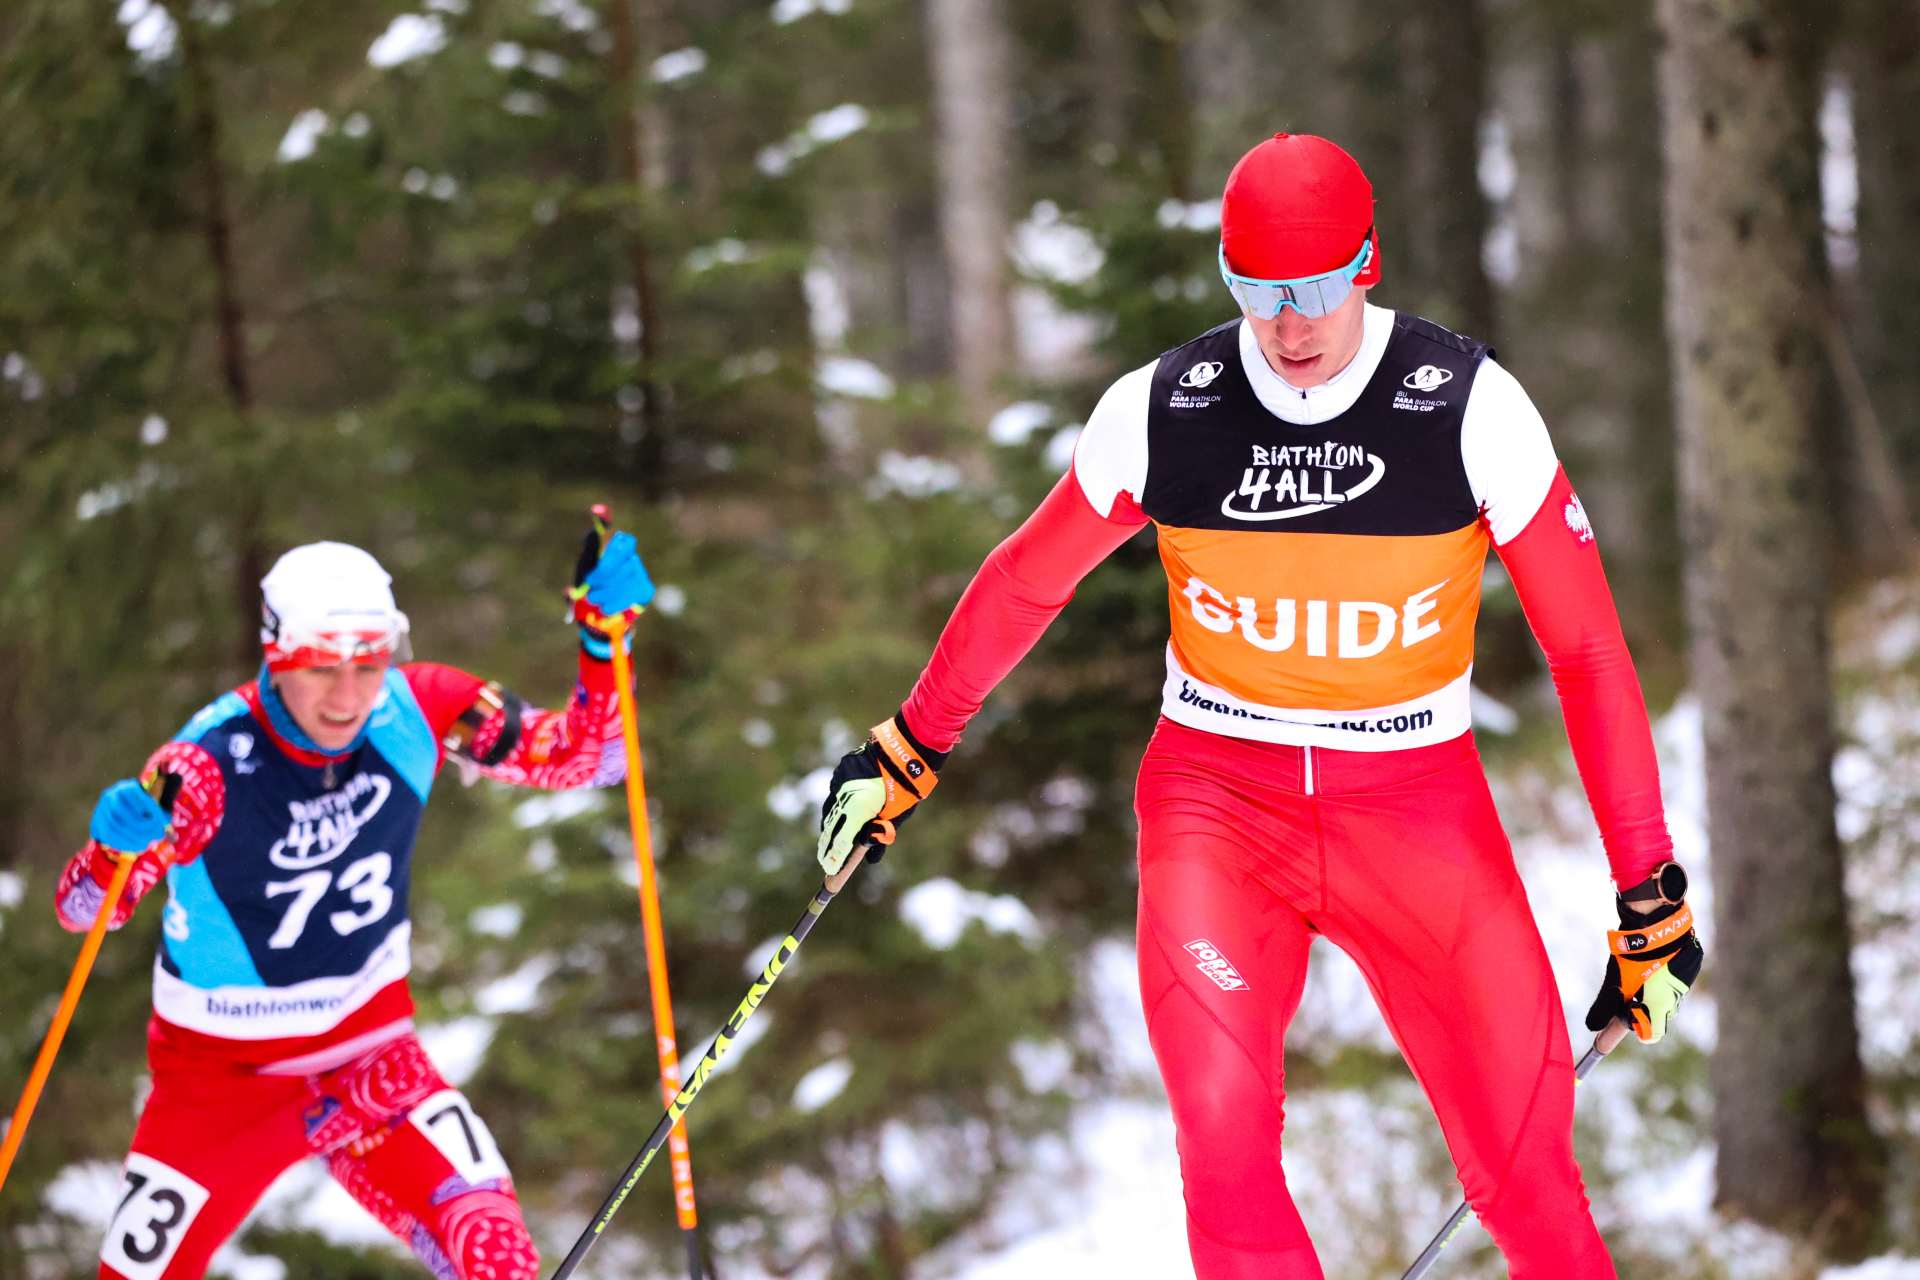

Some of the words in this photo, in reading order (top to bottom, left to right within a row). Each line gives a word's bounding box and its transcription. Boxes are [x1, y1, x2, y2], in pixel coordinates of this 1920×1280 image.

[1414, 399, 1447, 407] BIATHLON
[1183, 576, 1450, 658] GUIDE
[265, 852, 394, 949] 73
[1187, 941, 1244, 989] FORZA
[109, 1171, 185, 1263] 73
